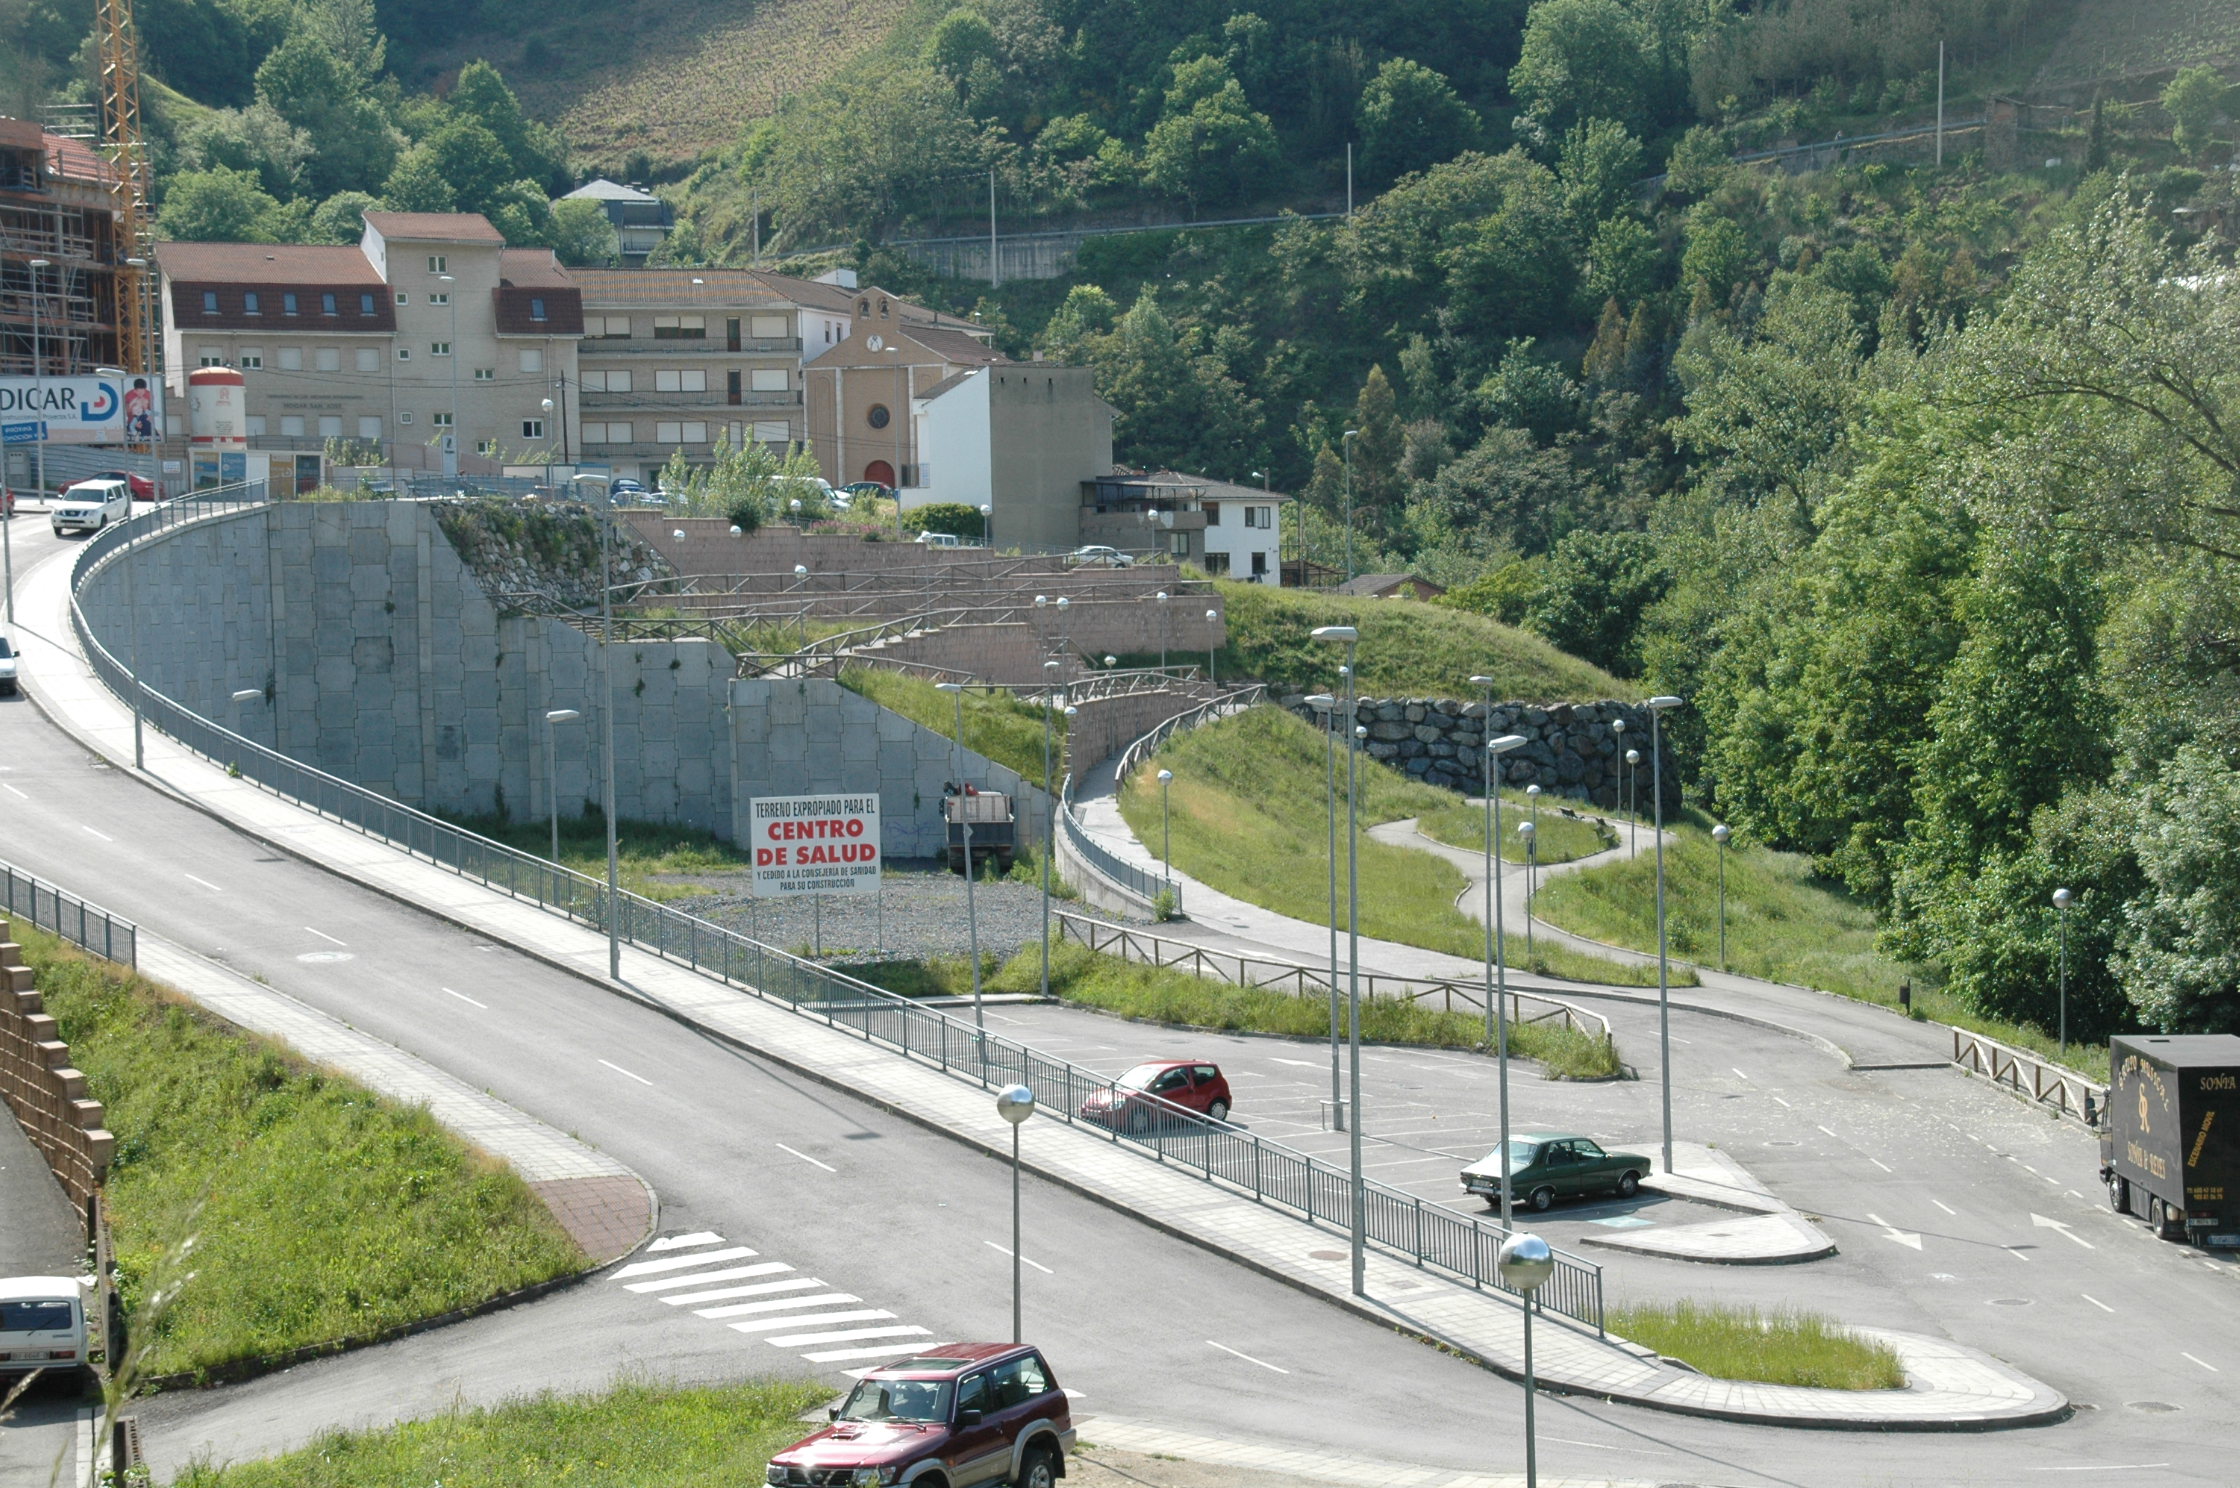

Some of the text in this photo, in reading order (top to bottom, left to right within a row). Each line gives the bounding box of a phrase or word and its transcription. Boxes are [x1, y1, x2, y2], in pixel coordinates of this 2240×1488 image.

[756, 798, 875, 818] TERRENO EXPROPIADO PARA EL
[767, 818, 864, 841] CENTRO
[756, 843, 876, 867] DE SALUD
[757, 871, 762, 880] Y
[762, 870, 786, 880] CEDIDO
[786, 870, 791, 879] A
[792, 869, 801, 879] LA
[840, 867, 848, 876] DE
[850, 865, 877, 876] SANIDAD
[780, 881, 796, 891] PARA
[797, 880, 806, 890] SU
[2118, 1055, 2170, 1112] GRUPO MUSICAL
[2200, 1072, 2236, 1091] SONIA
[2187, 1131, 2207, 1168] ESCENARIO
